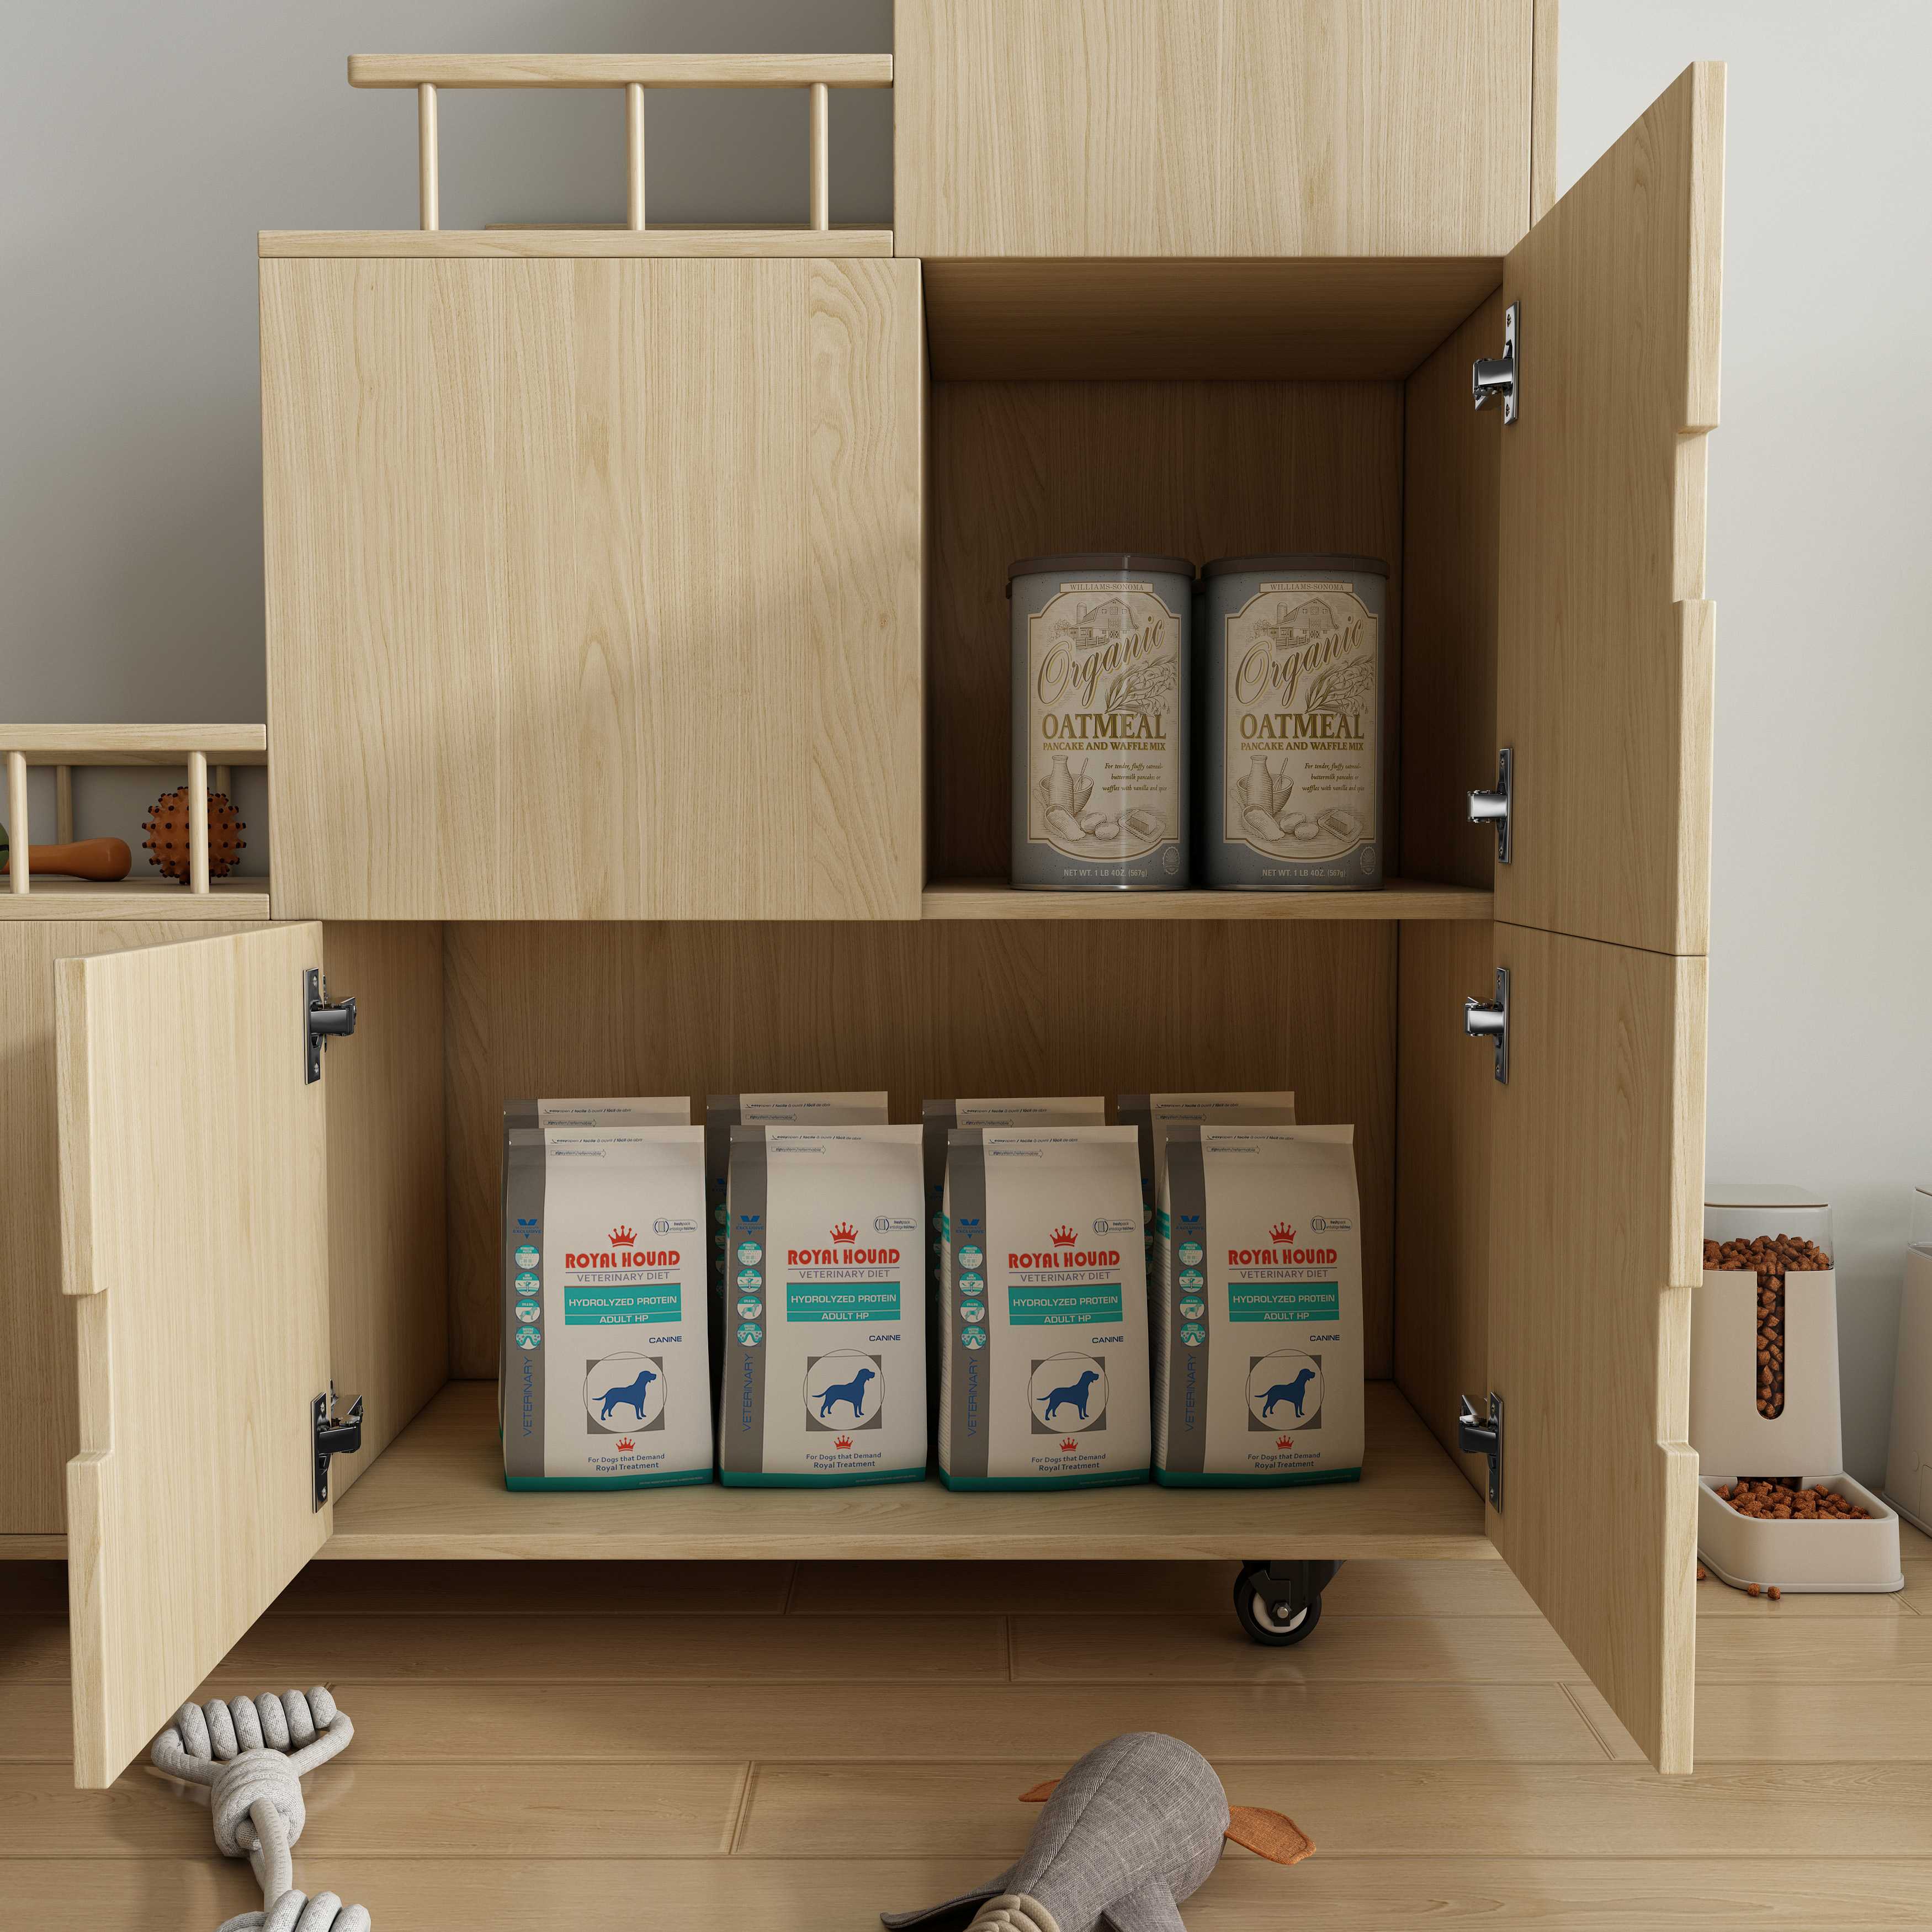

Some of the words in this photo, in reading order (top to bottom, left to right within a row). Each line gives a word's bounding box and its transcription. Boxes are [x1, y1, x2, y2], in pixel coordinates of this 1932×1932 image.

[1038, 615, 1165, 708] Organic
[1235, 615, 1364, 708] Organic
[1042, 714, 1166, 740] OATMEAL
[1240, 714, 1365, 740] OATMEAL
[1043, 742, 1084, 750] PANCAKE
[1086, 742, 1108, 750] AND
[1110, 742, 1148, 750] WAFFLE
[1149, 742, 1166, 750] MIX
[1241, 742, 1283, 750] PANCAKE
[1286, 742, 1307, 750] AND
[1310, 742, 1347, 750] WAFFLE
[1349, 742, 1364, 750] MIX
[1131, 763, 1144, 771] fluffy
[1331, 763, 1344, 771] fluffy
[565, 1253, 617, 1268] ROYAL
[622, 1250, 680, 1267] HOUND
[788, 1250, 838, 1265] ROYAL
[843, 1249, 900, 1264] HOUND
[1008, 1253, 1059, 1268] ROYAL
[1064, 1250, 1119, 1267] HOUND
[1228, 1250, 1278, 1265] ROYAL
[1283, 1249, 1337, 1264] HOUND
[577, 1273, 643, 1282] VETERINARY
[647, 1272, 670, 1280] DIET
[799, 1270, 864, 1278] VETERINARY
[868, 1270, 890, 1278] DIET
[1021, 1273, 1085, 1282] VETERINARY
[1089, 1272, 1111, 1280] DIET
[1240, 1270, 1303, 1278] VETERINARY
[1307, 1270, 1328, 1278] DIET
[569, 1298, 634, 1307] HYDROLYZED
[637, 1296, 677, 1305] PROTEIN
[791, 1295, 856, 1303] HYDROLYZED
[1013, 1298, 1077, 1307] HYDROLYZED
[1080, 1296, 1118, 1305] PROTEIN
[1233, 1295, 1296, 1303] HYDROLYZED
[599, 1315, 632, 1323] ADULT
[1044, 1315, 1075, 1323] ADULT
[523, 1356, 534, 1436] VETERINARY
[742, 1353, 754, 1431] VETERINARY
[968, 1357, 980, 1436] VETERINARY
[1185, 1353, 1197, 1431] VETERINARY
[596, 1464, 617, 1472] Royal
[619, 1462, 659, 1470] Treatment
[1039, 1464, 1060, 1472] Royal
[1061, 1462, 1100, 1470] Treatment
